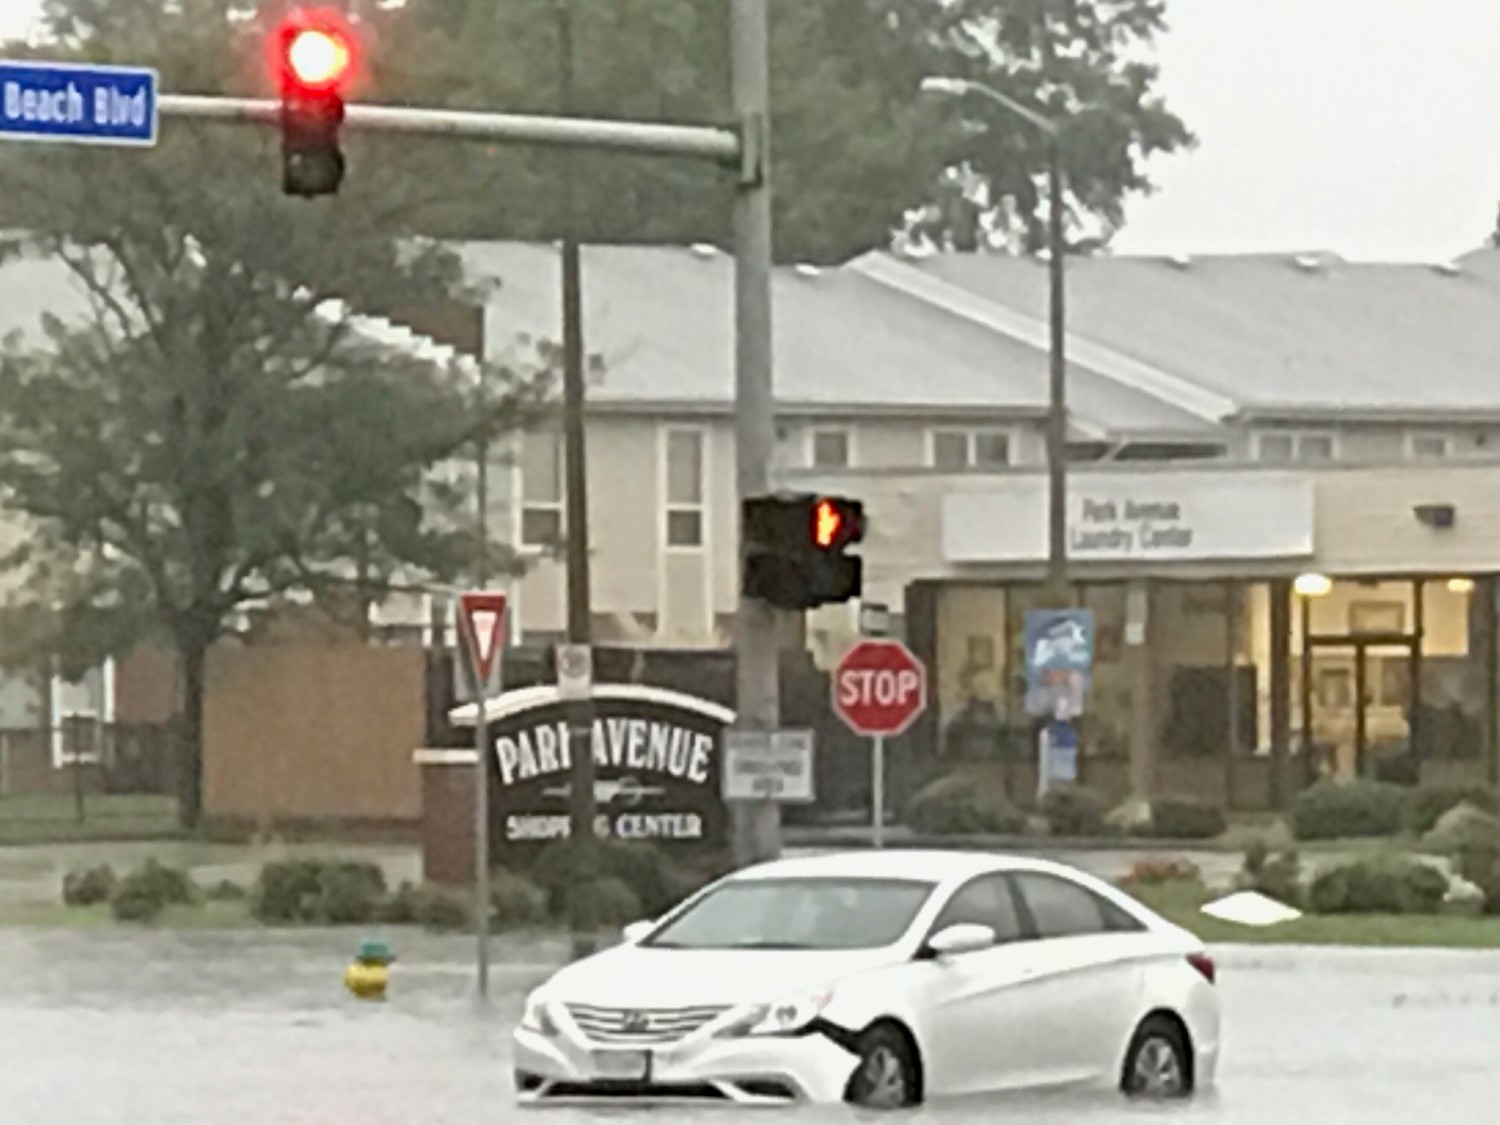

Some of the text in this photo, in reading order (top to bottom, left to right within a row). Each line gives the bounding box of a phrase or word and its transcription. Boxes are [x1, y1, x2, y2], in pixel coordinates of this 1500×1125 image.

[4, 80, 146, 127] Beach Blvd
[1083, 499, 1181, 522] Park Avenue
[1139, 522, 1193, 549] Center
[839, 669, 919, 707] STOP
[590, 717, 714, 784] AVENUE
[506, 813, 702, 841] SHOPPG CENTER
